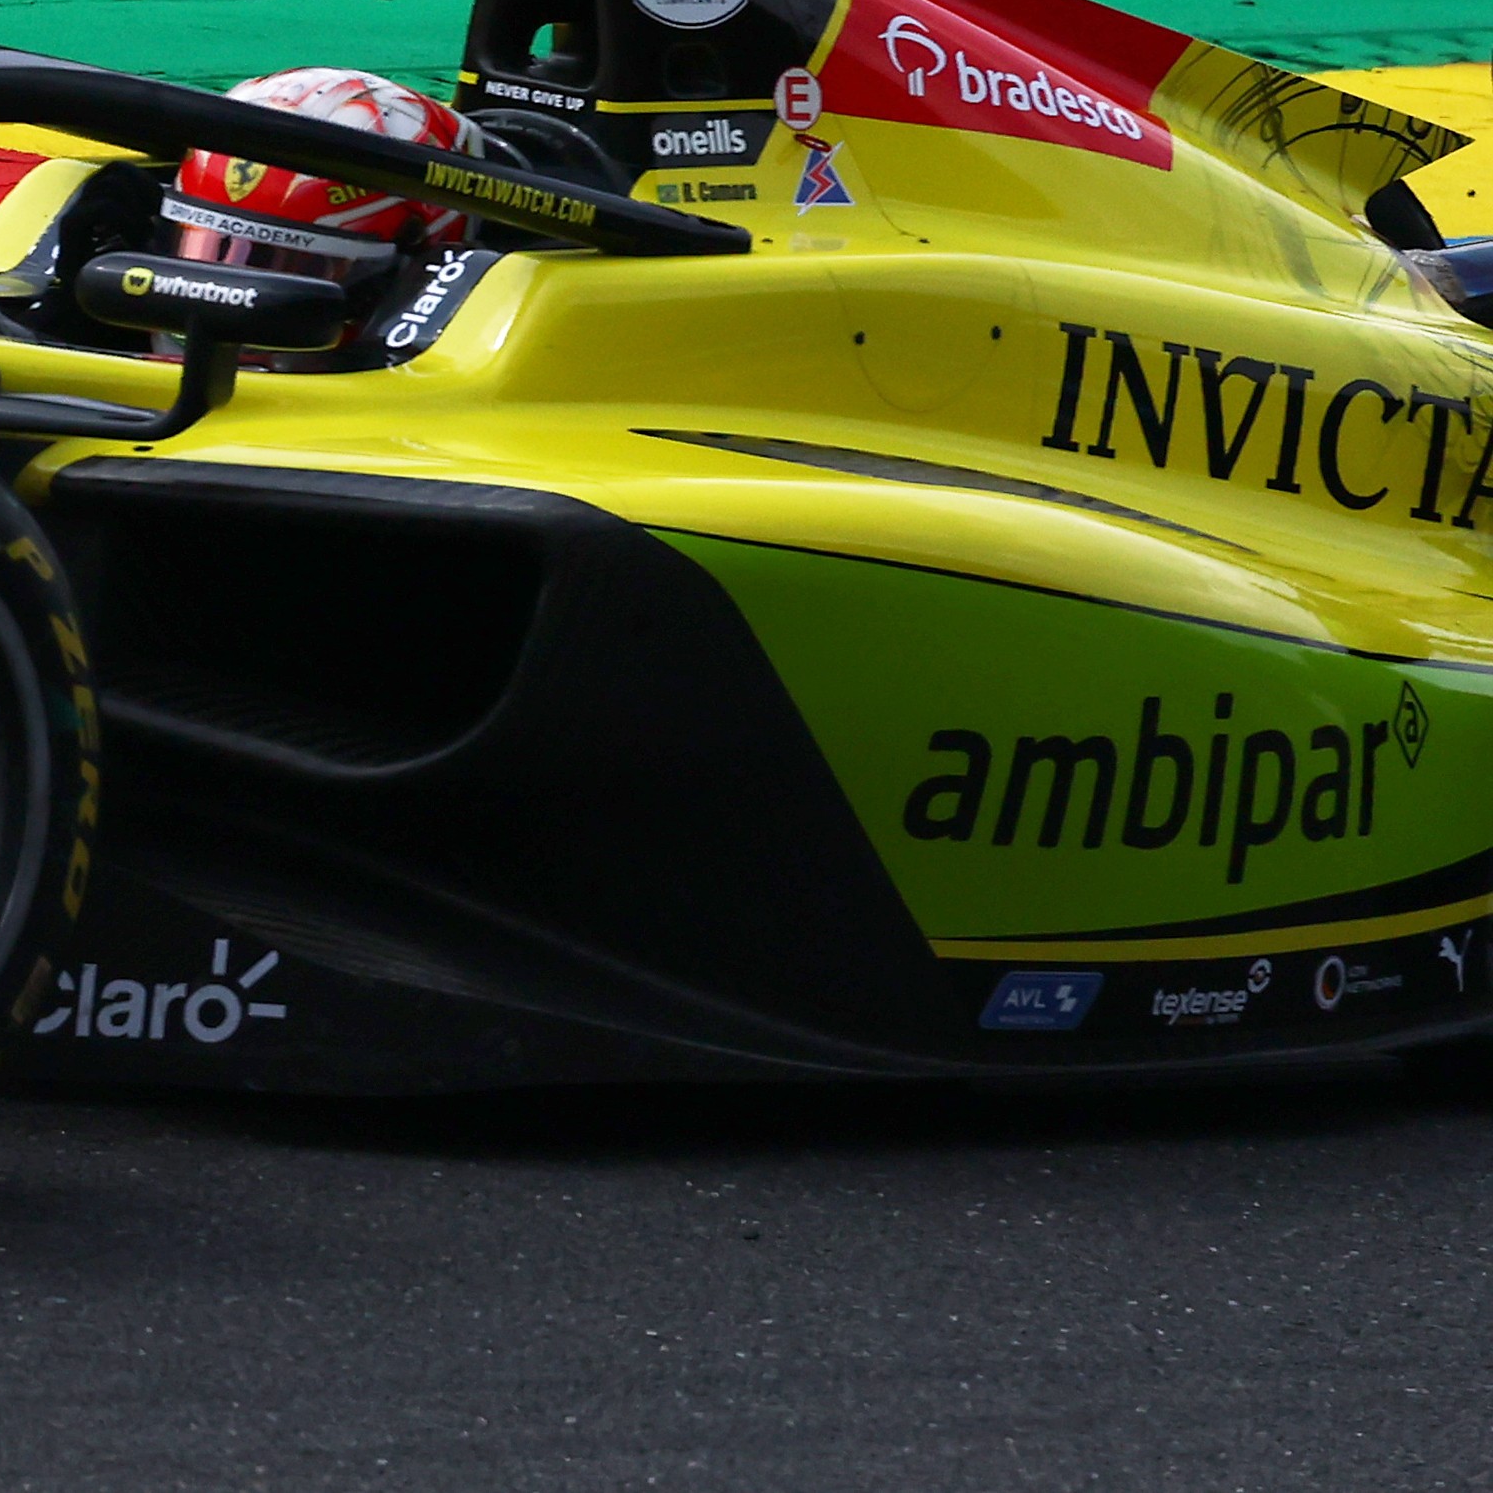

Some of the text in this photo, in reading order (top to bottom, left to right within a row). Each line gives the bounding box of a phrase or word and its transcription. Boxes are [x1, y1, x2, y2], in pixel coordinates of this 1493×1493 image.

[485, 80, 586, 112] NEVER GIVE UP
[786, 75, 811, 121] E
[955, 50, 1143, 140] bradesco
[424, 160, 597, 227] INVICTAWATCH.COM
[218, 217, 315, 248] ACADEMY
[153, 275, 259, 308] whatnot
[386, 261, 466, 348] Claro
[903, 693, 1389, 885] ambipar
[1003, 988, 1047, 1009] AVL
